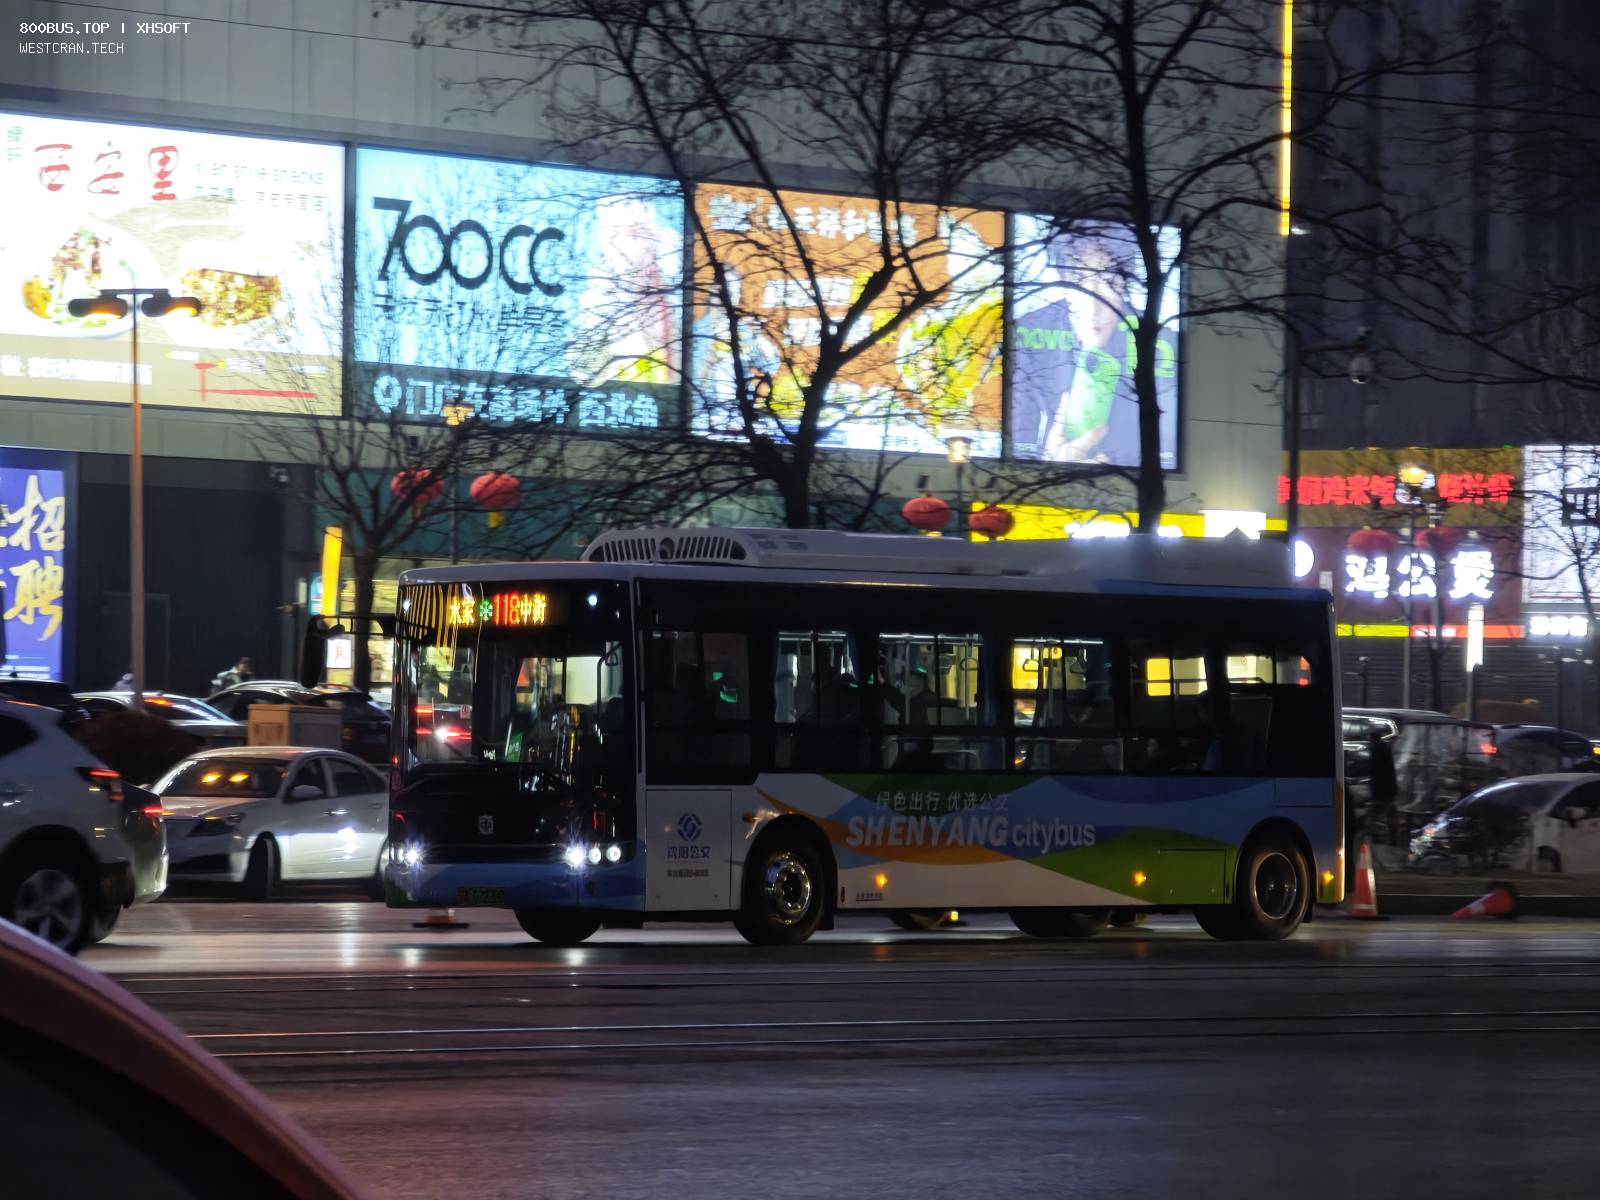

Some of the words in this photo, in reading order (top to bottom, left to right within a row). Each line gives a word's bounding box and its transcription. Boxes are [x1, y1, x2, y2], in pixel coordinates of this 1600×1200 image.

[3, 474, 65, 641] 招聘
[493, 592, 520, 625] 118
[875, 790, 941, 812] 绿色出行
[846, 814, 1009, 848] SHENYANG
[1012, 816, 1097, 854] citybus
